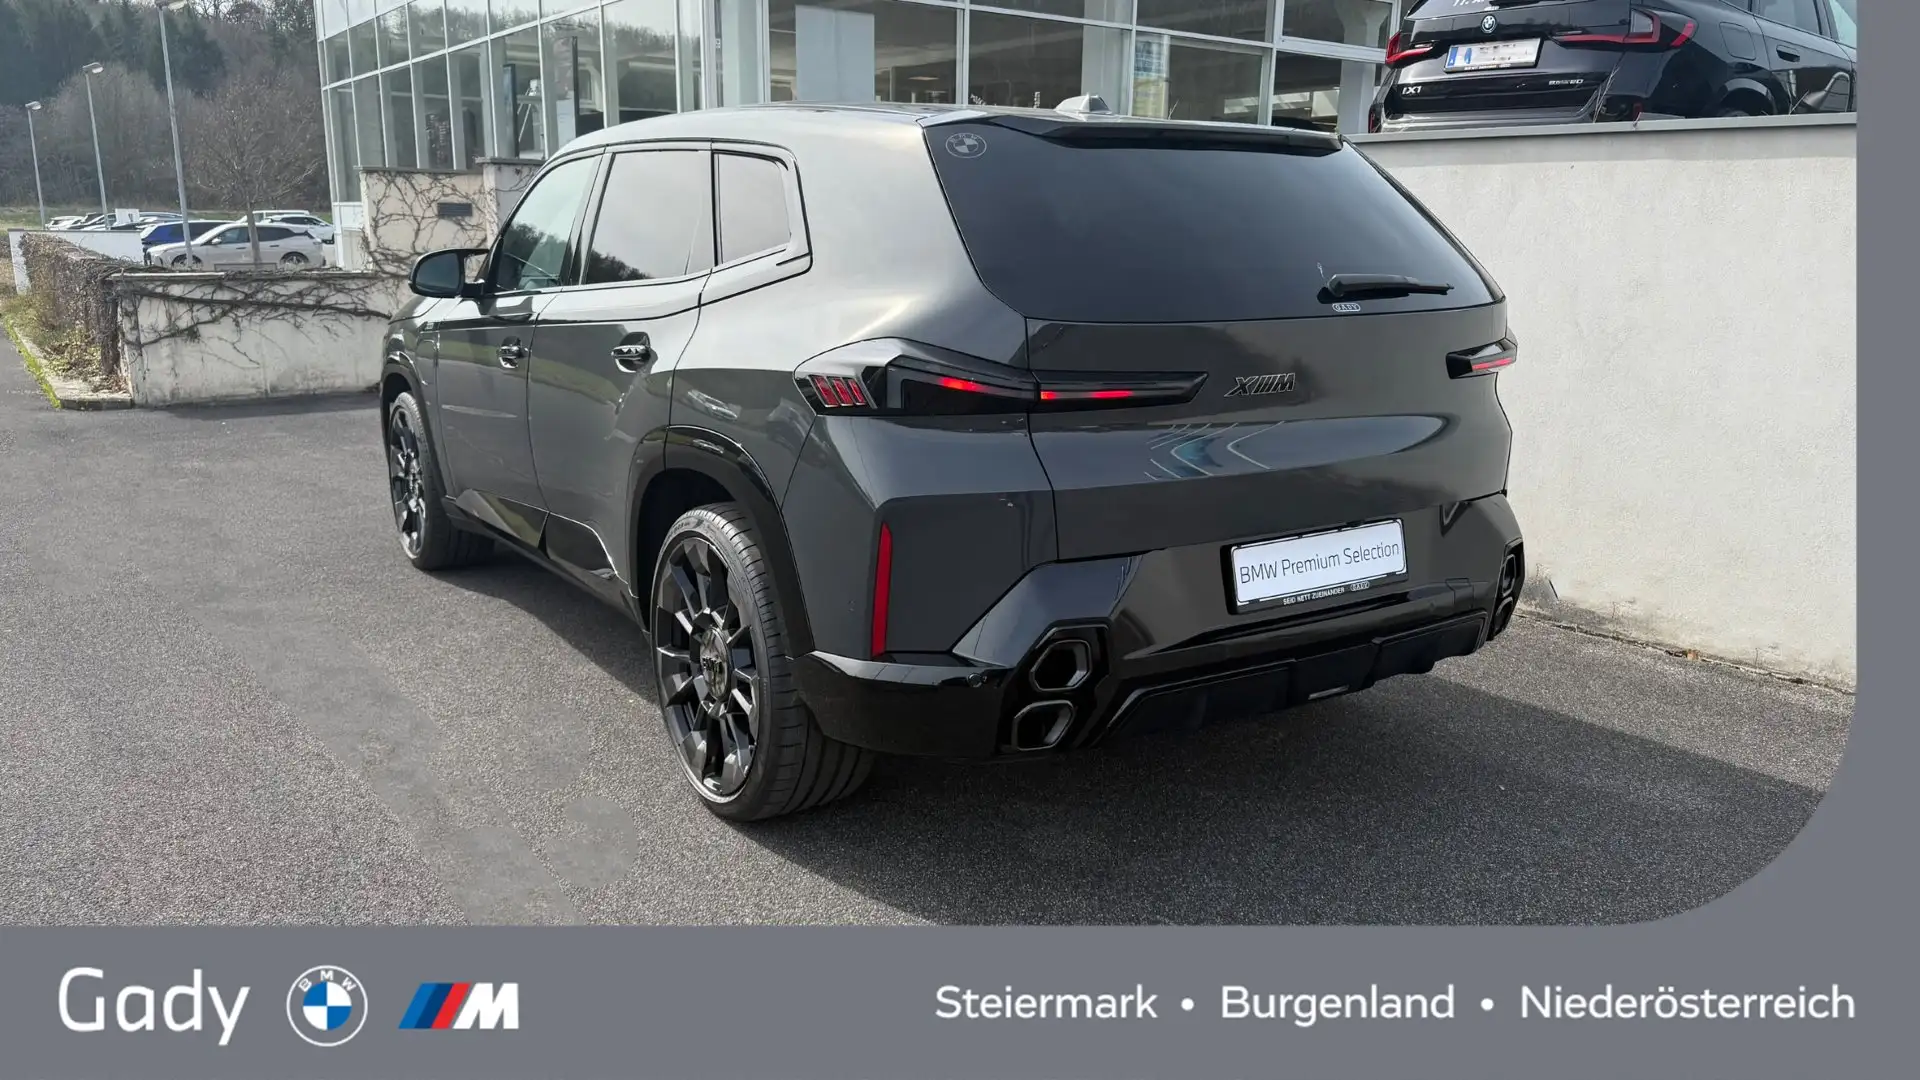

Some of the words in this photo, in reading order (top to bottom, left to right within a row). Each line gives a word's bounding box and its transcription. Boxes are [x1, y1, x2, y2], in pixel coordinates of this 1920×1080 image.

[1240, 561, 1277, 584] BMW
[1281, 552, 1341, 577] Premium
[1343, 542, 1400, 565] Selection
[1312, 587, 1345, 599] ZUEINANDER
